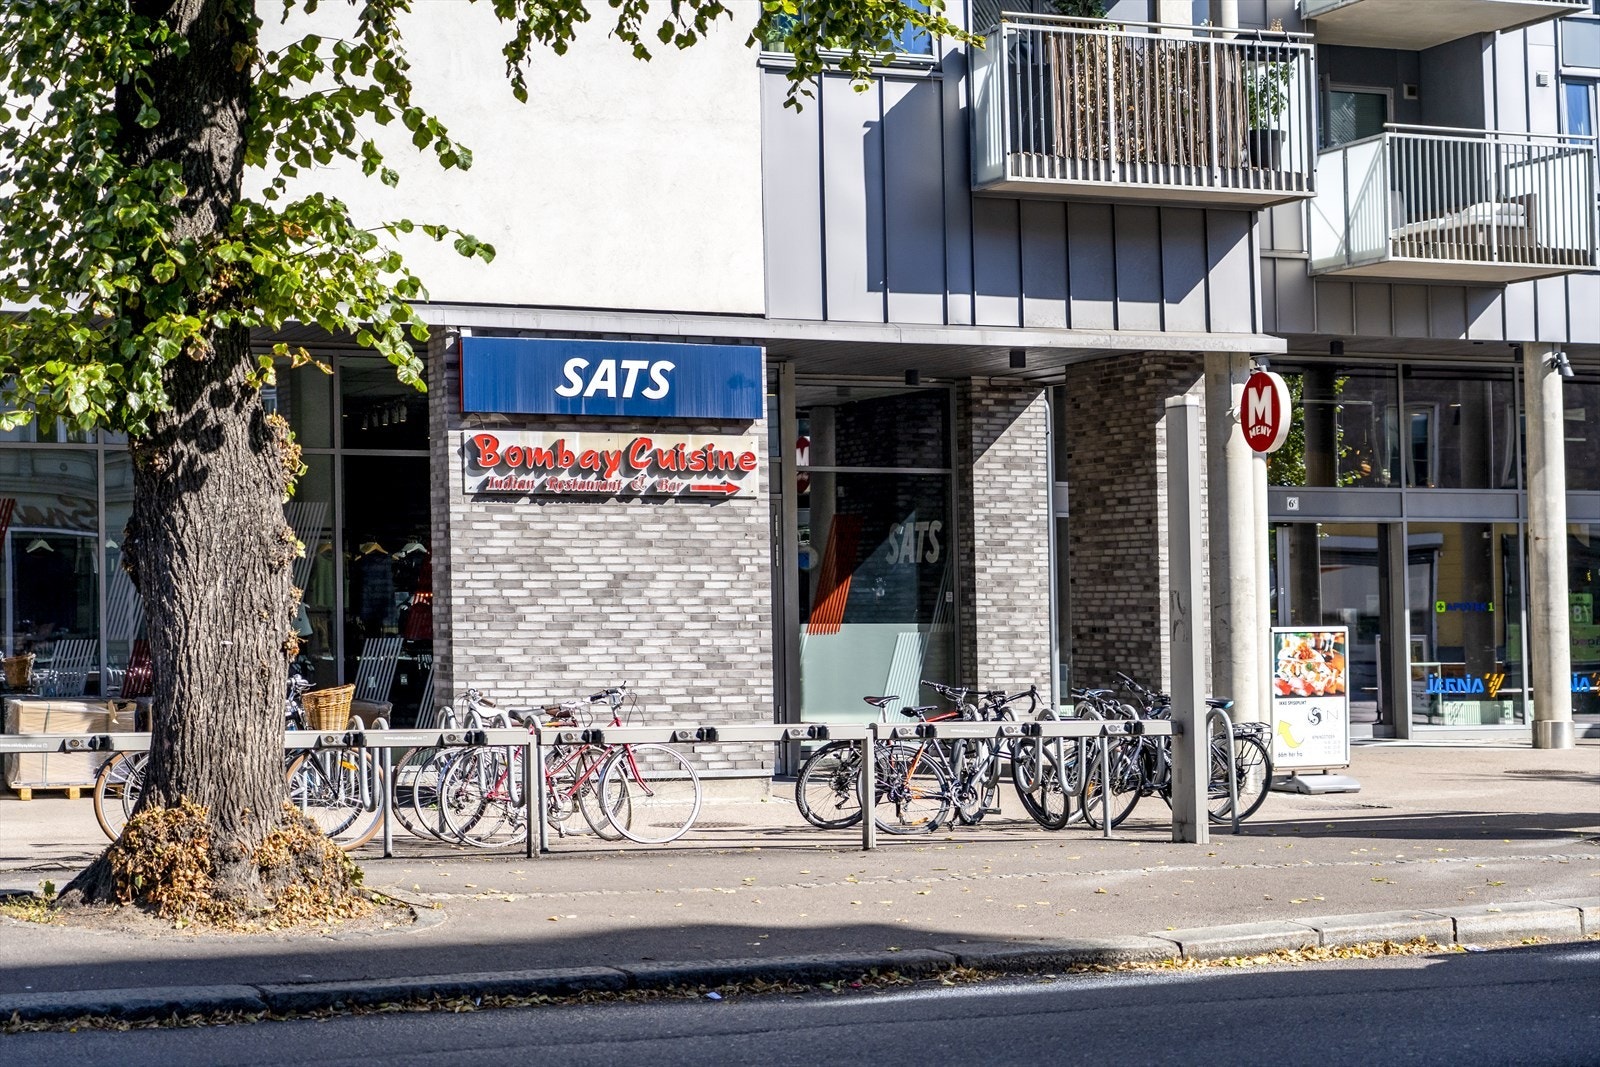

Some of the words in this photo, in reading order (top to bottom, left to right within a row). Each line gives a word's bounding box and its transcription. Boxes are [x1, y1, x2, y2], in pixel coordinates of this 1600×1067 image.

[555, 357, 676, 399] SATS
[1248, 385, 1272, 428] M
[1249, 425, 1272, 439] MENY
[472, 433, 622, 479] Bombay
[629, 436, 757, 471] Cuisine
[486, 475, 535, 491] Indian
[545, 475, 622, 493] Restaurant
[656, 478, 685, 493] Bar
[885, 520, 943, 565] SATS
[1488, 602, 1495, 611] 1
